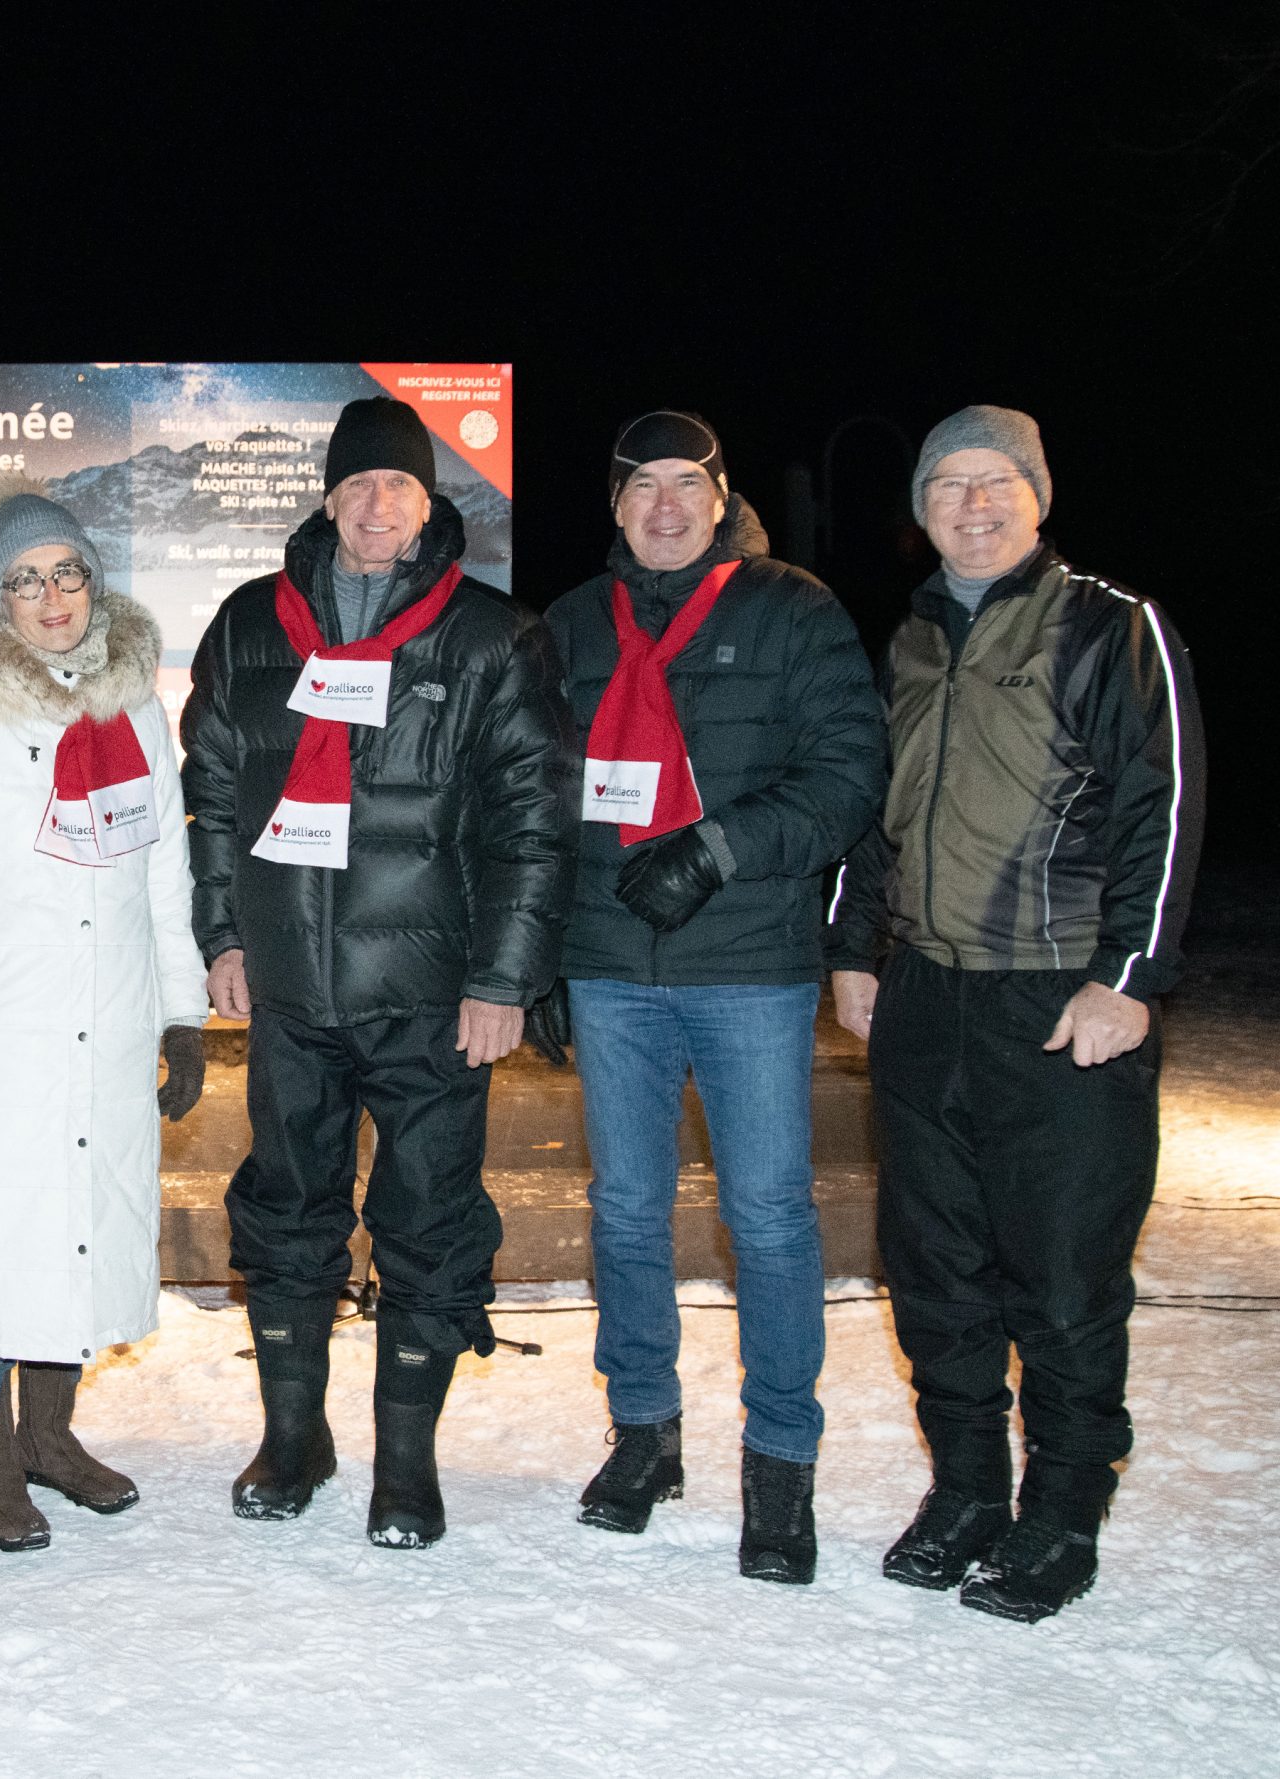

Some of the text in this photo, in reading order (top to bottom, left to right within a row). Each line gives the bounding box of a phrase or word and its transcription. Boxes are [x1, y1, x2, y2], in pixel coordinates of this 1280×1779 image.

[398, 377, 501, 387] INSCRIVEZ-VOUS ICI
[421, 391, 501, 401] REGISTER HERE
[159, 419, 336, 433] Skiez, marchez ou chaus
[206, 440, 231, 452] vos
[234, 440, 302, 455] raquettes
[201, 463, 256, 475] MARCHE
[265, 463, 294, 477] piste
[297, 463, 317, 475] M1
[193, 479, 268, 491] RAQUETTES
[276, 479, 306, 493] piste
[220, 496, 240, 508] SKI
[248, 495, 278, 509] piste
[280, 496, 297, 508] A1
[196, 544, 231, 559] walk
[234, 548, 250, 559] or
[326, 683, 374, 695] palliacco
[605, 785, 641, 798] palliacco
[114, 804, 147, 822] palliacco
[58, 823, 95, 835] palliacc
[283, 822, 331, 838] palliacco
[399, 1351, 426, 1361] BOGS
